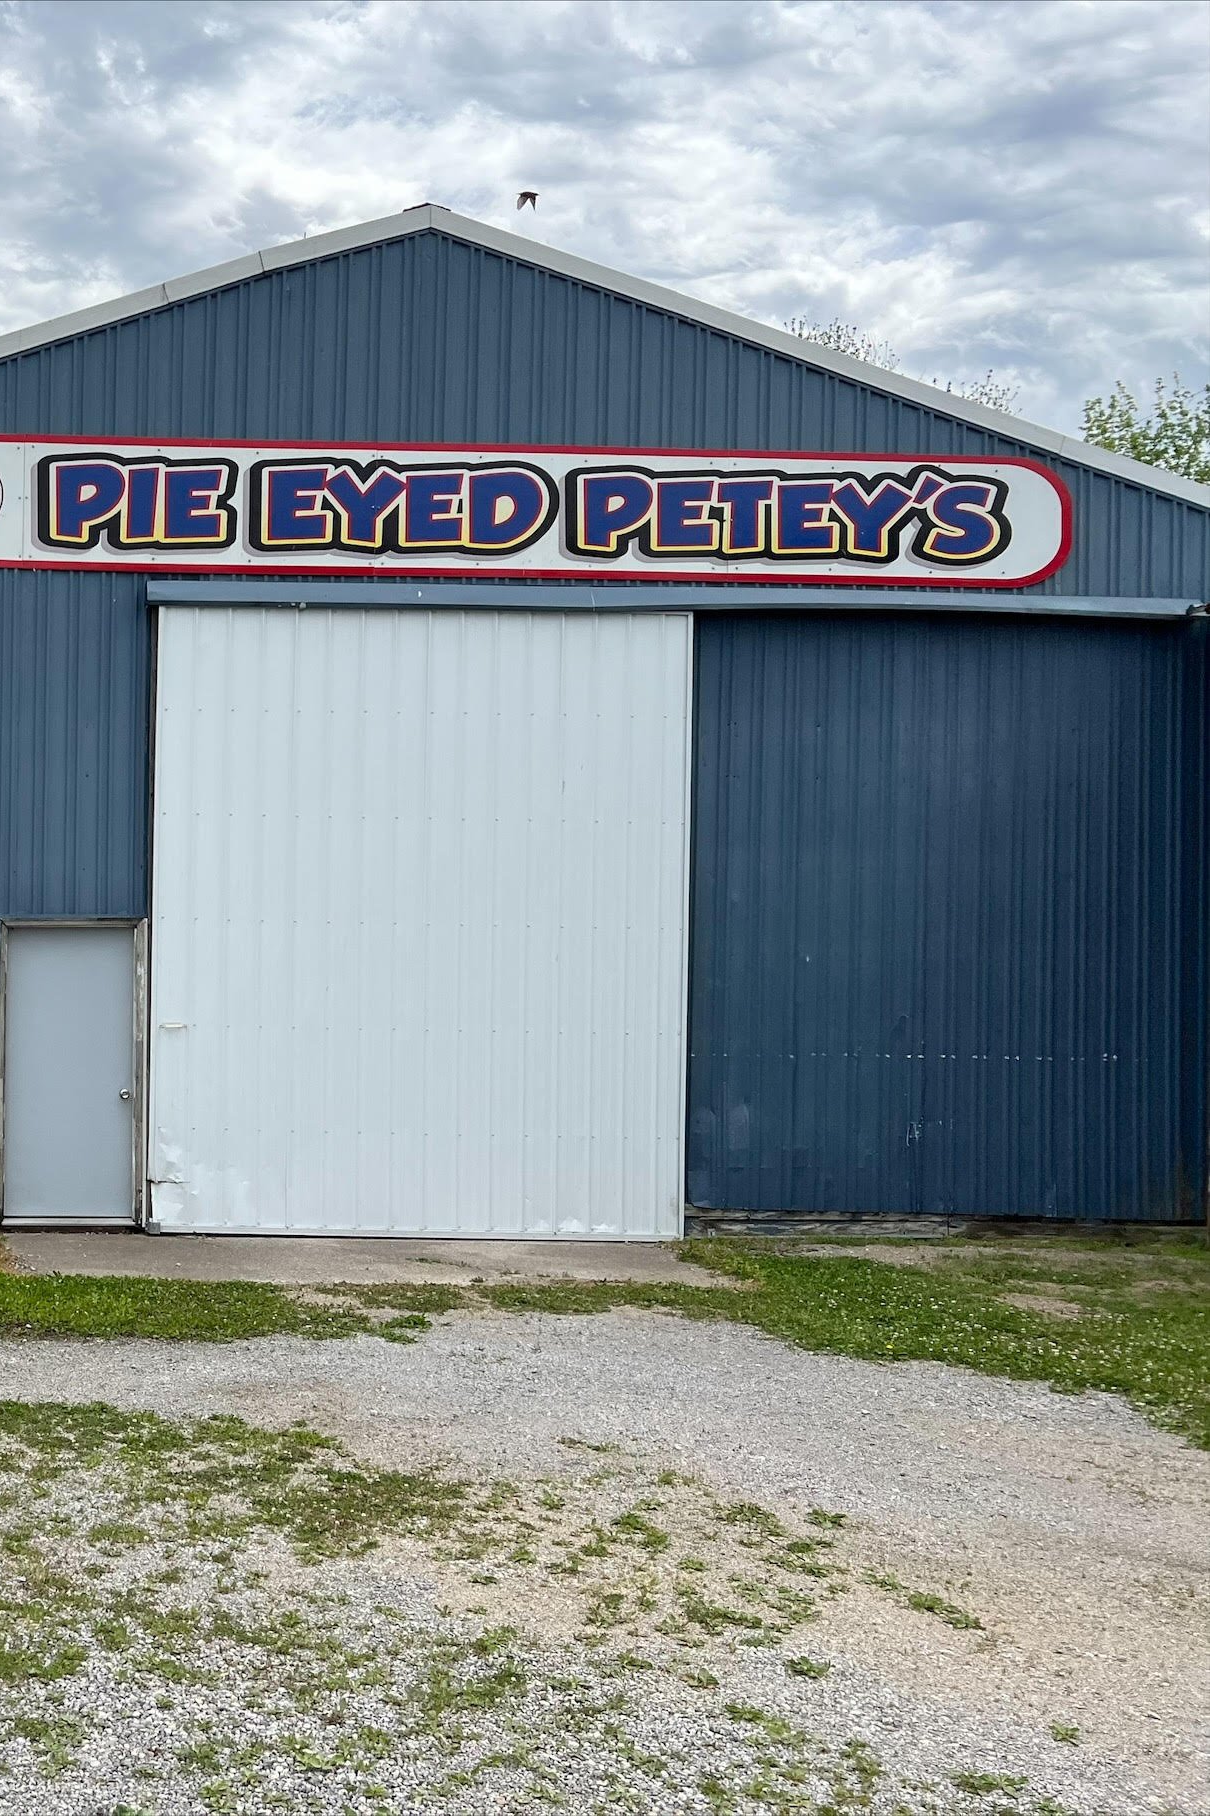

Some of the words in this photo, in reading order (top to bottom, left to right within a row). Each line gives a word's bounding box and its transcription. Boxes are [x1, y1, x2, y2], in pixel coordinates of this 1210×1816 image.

[48, 460, 226, 543] PIE
[264, 465, 548, 554] EYED
[575, 470, 996, 560] PETEY'S
